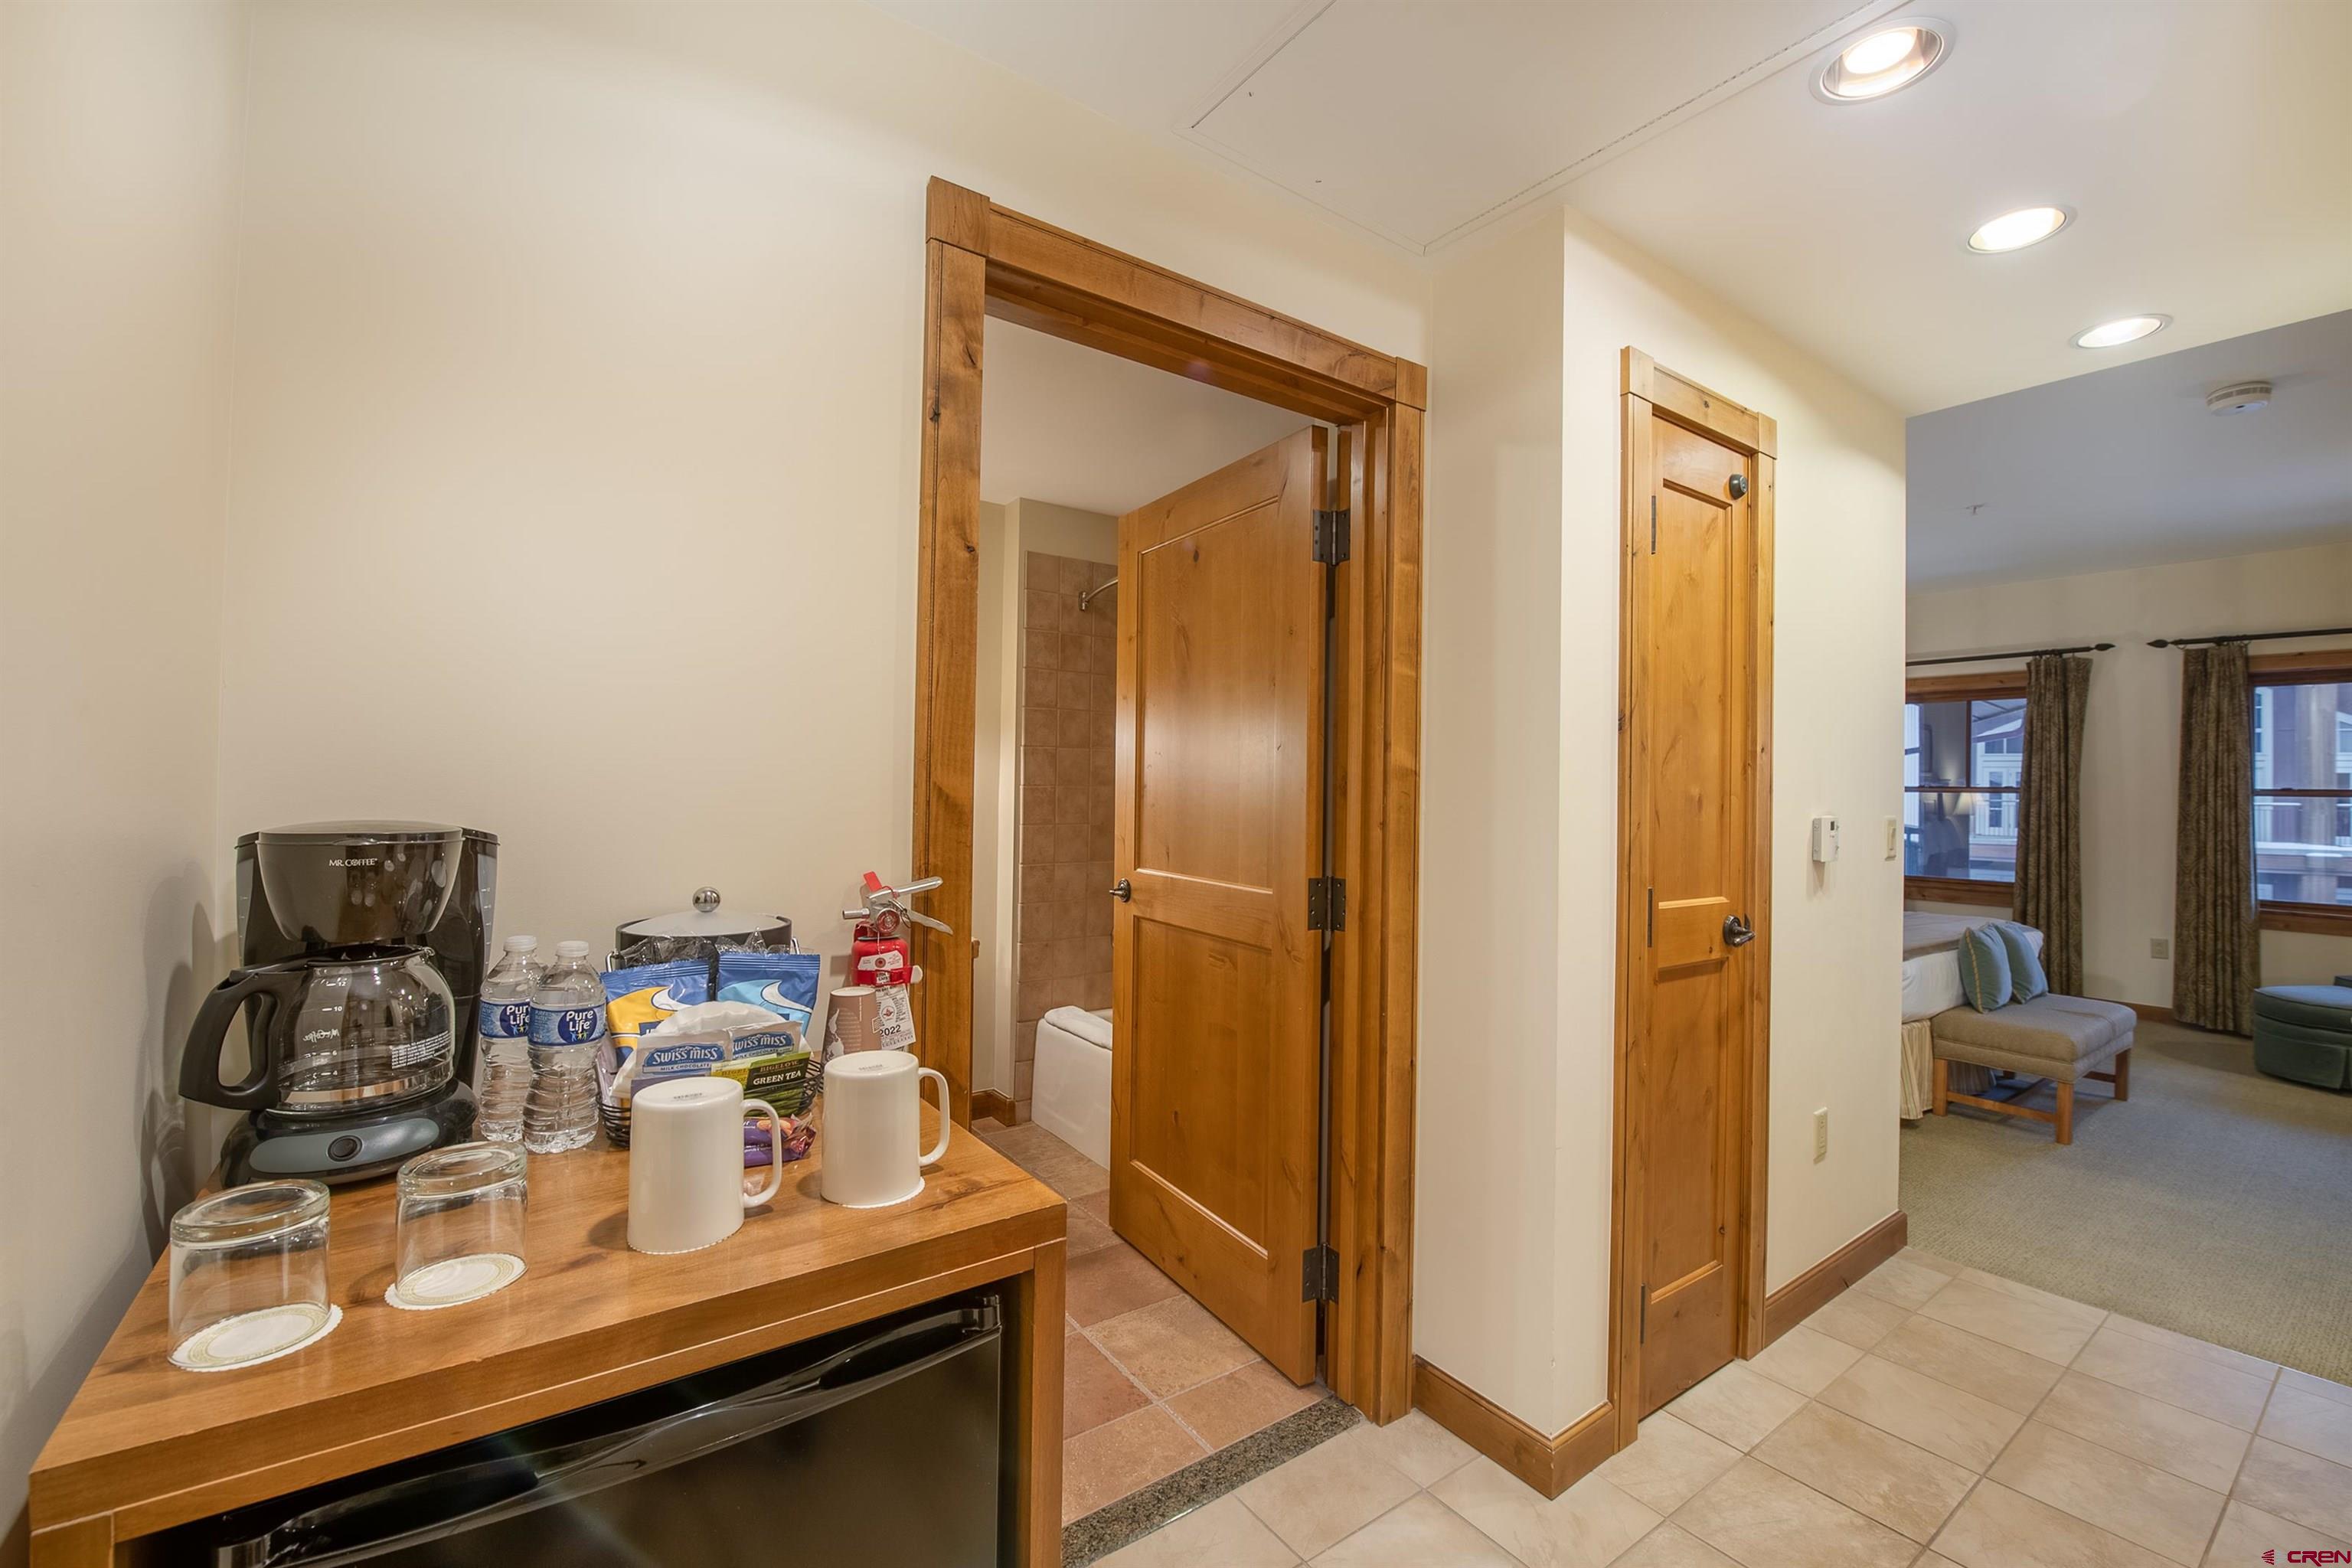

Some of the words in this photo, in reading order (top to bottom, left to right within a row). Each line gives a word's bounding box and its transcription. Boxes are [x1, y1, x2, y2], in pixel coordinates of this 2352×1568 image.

[507, 1004, 531, 1015] Pur
[567, 1010, 593, 1021] Pure
[569, 1019, 590, 1033] Life
[733, 1037, 759, 1052] WISS
[675, 1062, 710, 1070] CHOCOLATE
[753, 1073, 784, 1086] GREEN
[786, 1070, 802, 1080] TEA
